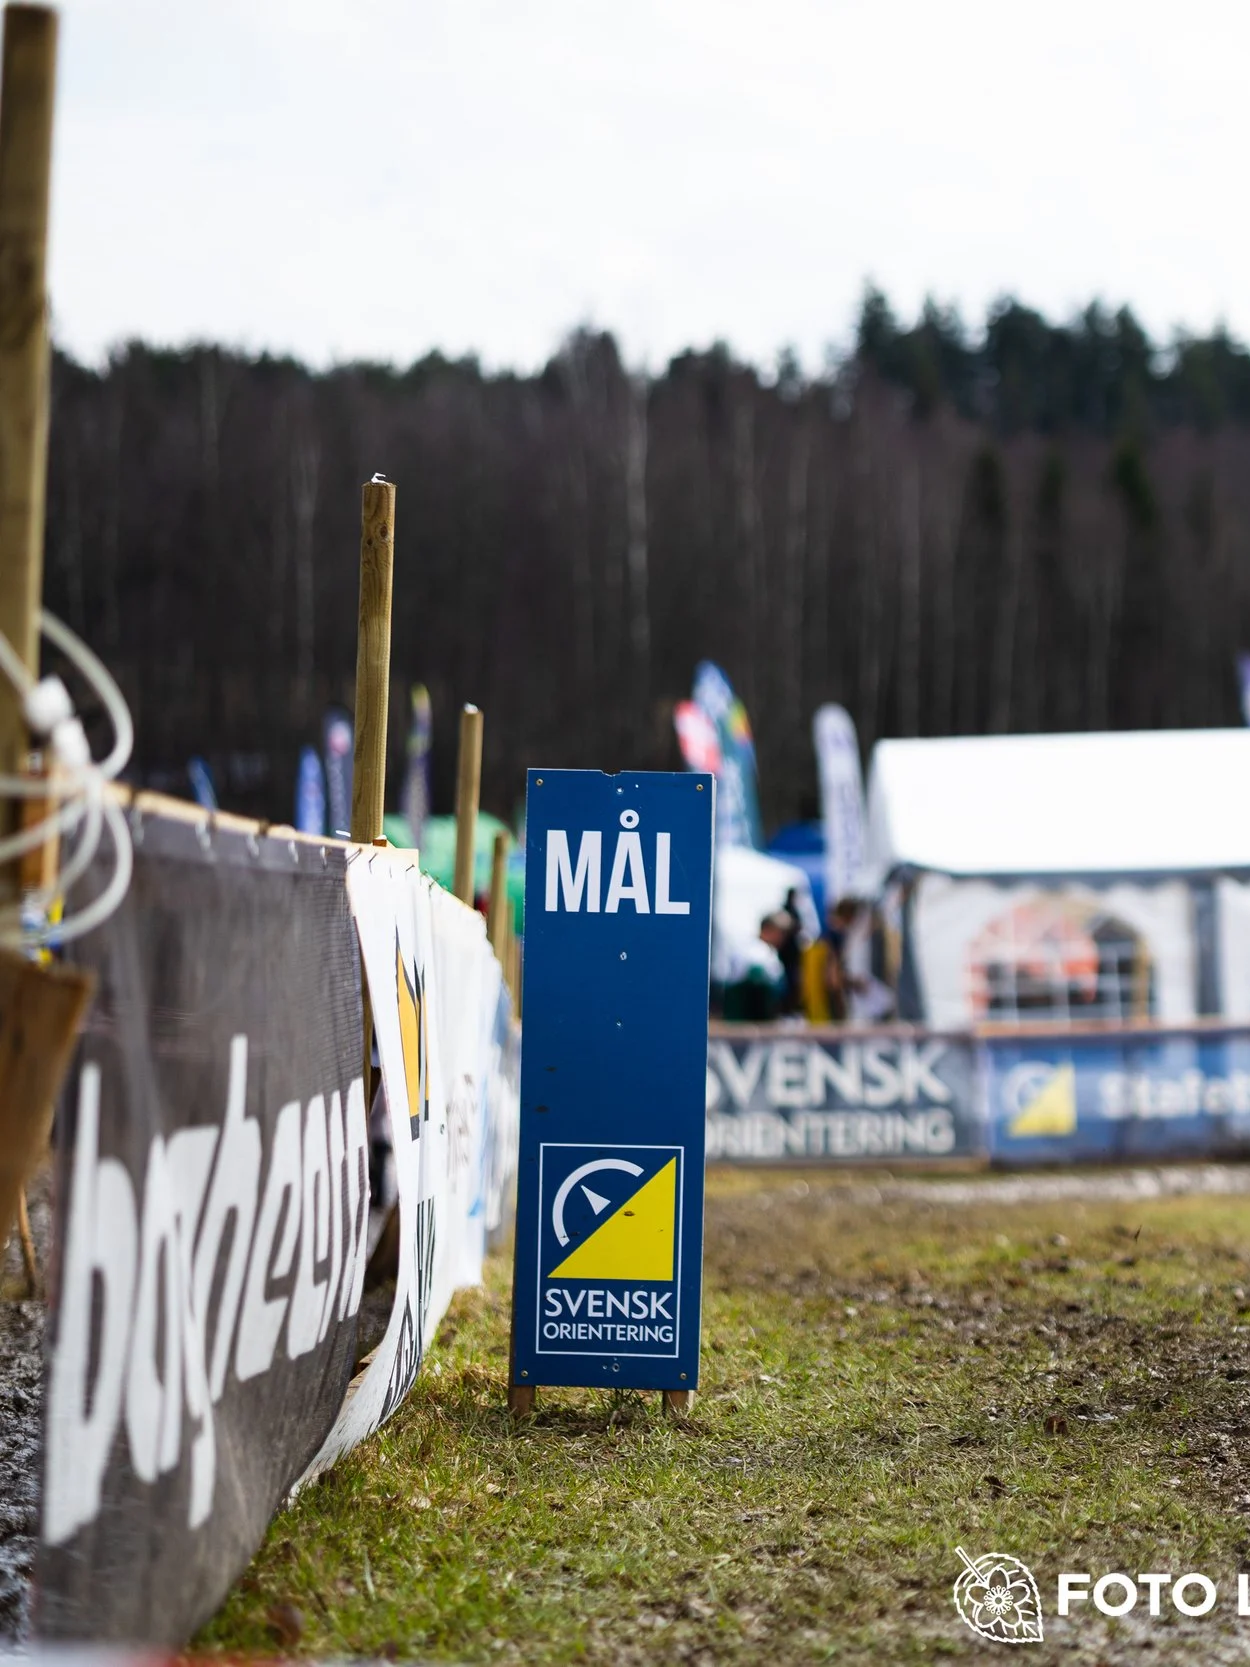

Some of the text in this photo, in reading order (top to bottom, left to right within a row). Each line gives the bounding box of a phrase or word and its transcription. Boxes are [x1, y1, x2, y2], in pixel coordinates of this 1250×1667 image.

[545, 809, 690, 915] MÅL
[544, 1288, 673, 1320] SVENSK
[543, 1322, 674, 1343] ORIENTERING
